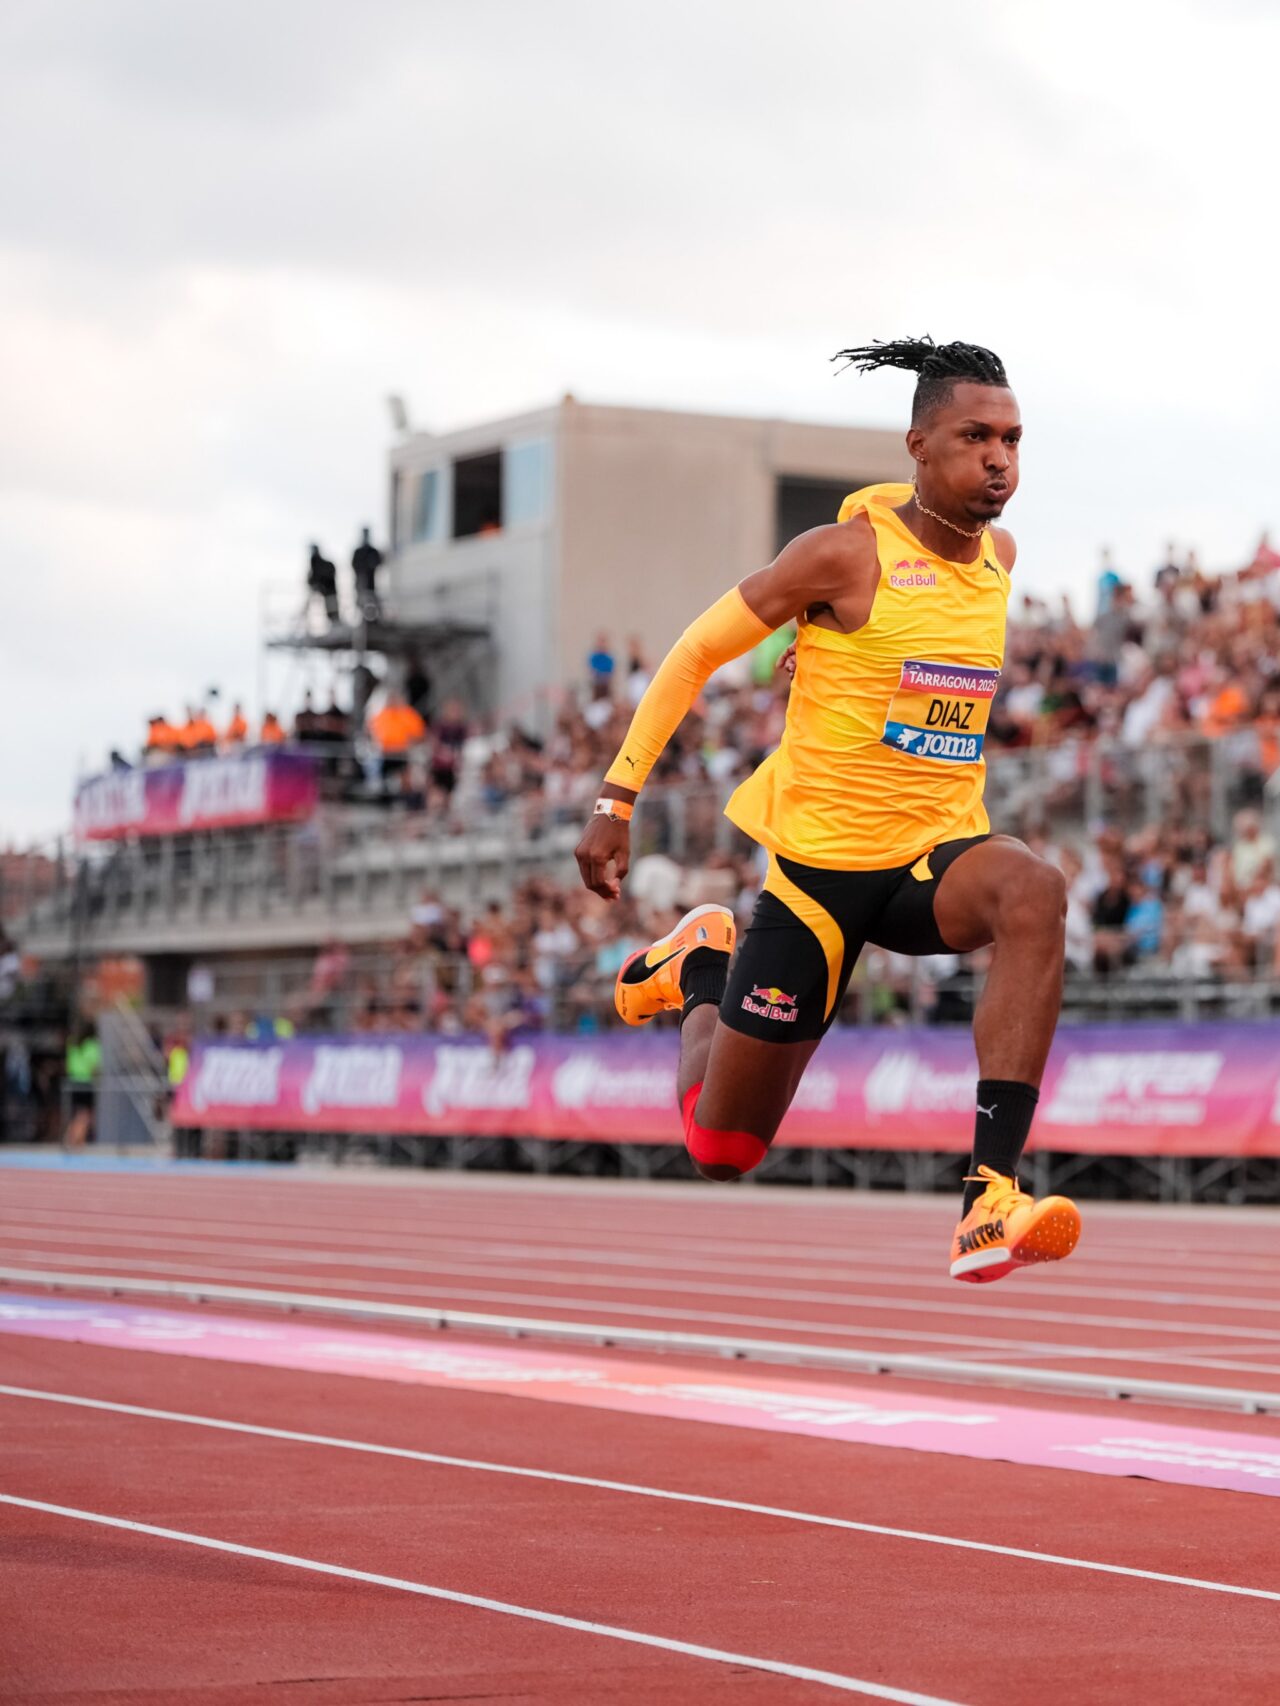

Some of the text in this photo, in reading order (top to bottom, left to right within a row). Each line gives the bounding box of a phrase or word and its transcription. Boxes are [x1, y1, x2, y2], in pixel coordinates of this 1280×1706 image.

[891, 573, 936, 587] Red Bull
[909, 670, 996, 692] TARRAGONA 2025
[925, 699, 975, 729] DIAZ
[741, 995, 799, 1022] Red Bull
[958, 1219, 1005, 1255] NITRO
